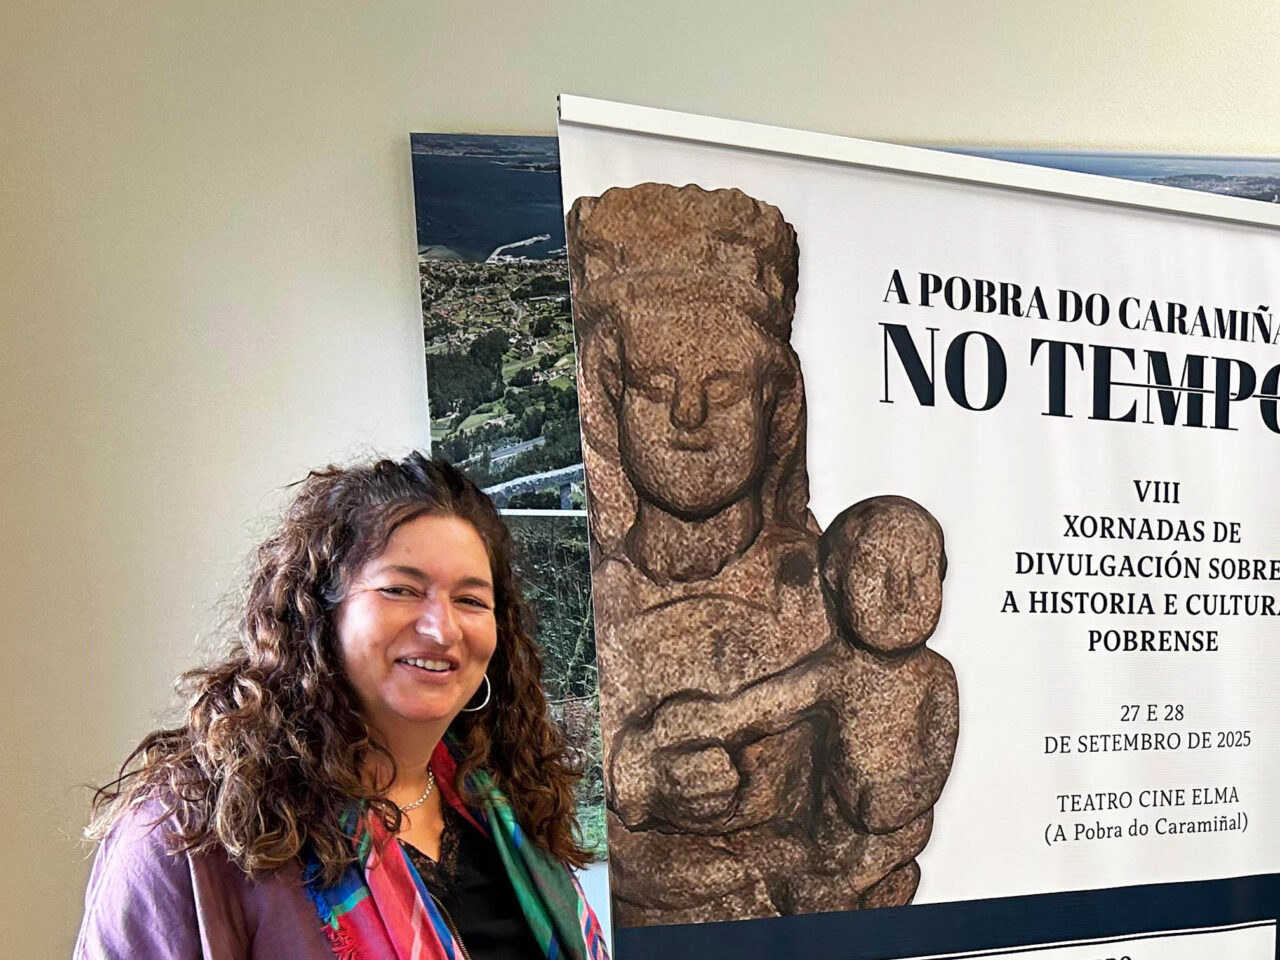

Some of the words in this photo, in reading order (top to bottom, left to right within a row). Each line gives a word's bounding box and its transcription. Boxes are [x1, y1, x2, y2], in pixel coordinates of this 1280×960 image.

[883, 270, 910, 304] A
[919, 273, 1049, 320] POBRA
[1058, 290, 1110, 326] DO
[878, 322, 1007, 411] NO
[1134, 480, 1180, 504] VIII
[1064, 515, 1204, 542] XORNADAS
[1213, 522, 1240, 543] DE
[1016, 550, 1200, 578] DIVULGACIÓN
[1001, 591, 1020, 612] A
[1029, 591, 1155, 614] HISTORIA
[1164, 594, 1177, 614] E
[1089, 630, 1218, 652] POBRENSE
[1121, 705, 1140, 721] 27
[1147, 704, 1157, 721] E
[1164, 705, 1184, 720] 28
[1045, 736, 1070, 754] DE
[1078, 733, 1180, 752] SETEMBRO
[1188, 732, 1211, 748] DE
[1218, 731, 1250, 748] 2025
[1057, 792, 1132, 812] TEATRO
[1139, 790, 1185, 807] CINE
[1192, 787, 1239, 805] ELMA
[1045, 824, 1066, 846] (A
[1074, 822, 1122, 840] Pobra
[1129, 819, 1148, 836] do
[1156, 812, 1248, 834] Caramiñal)
